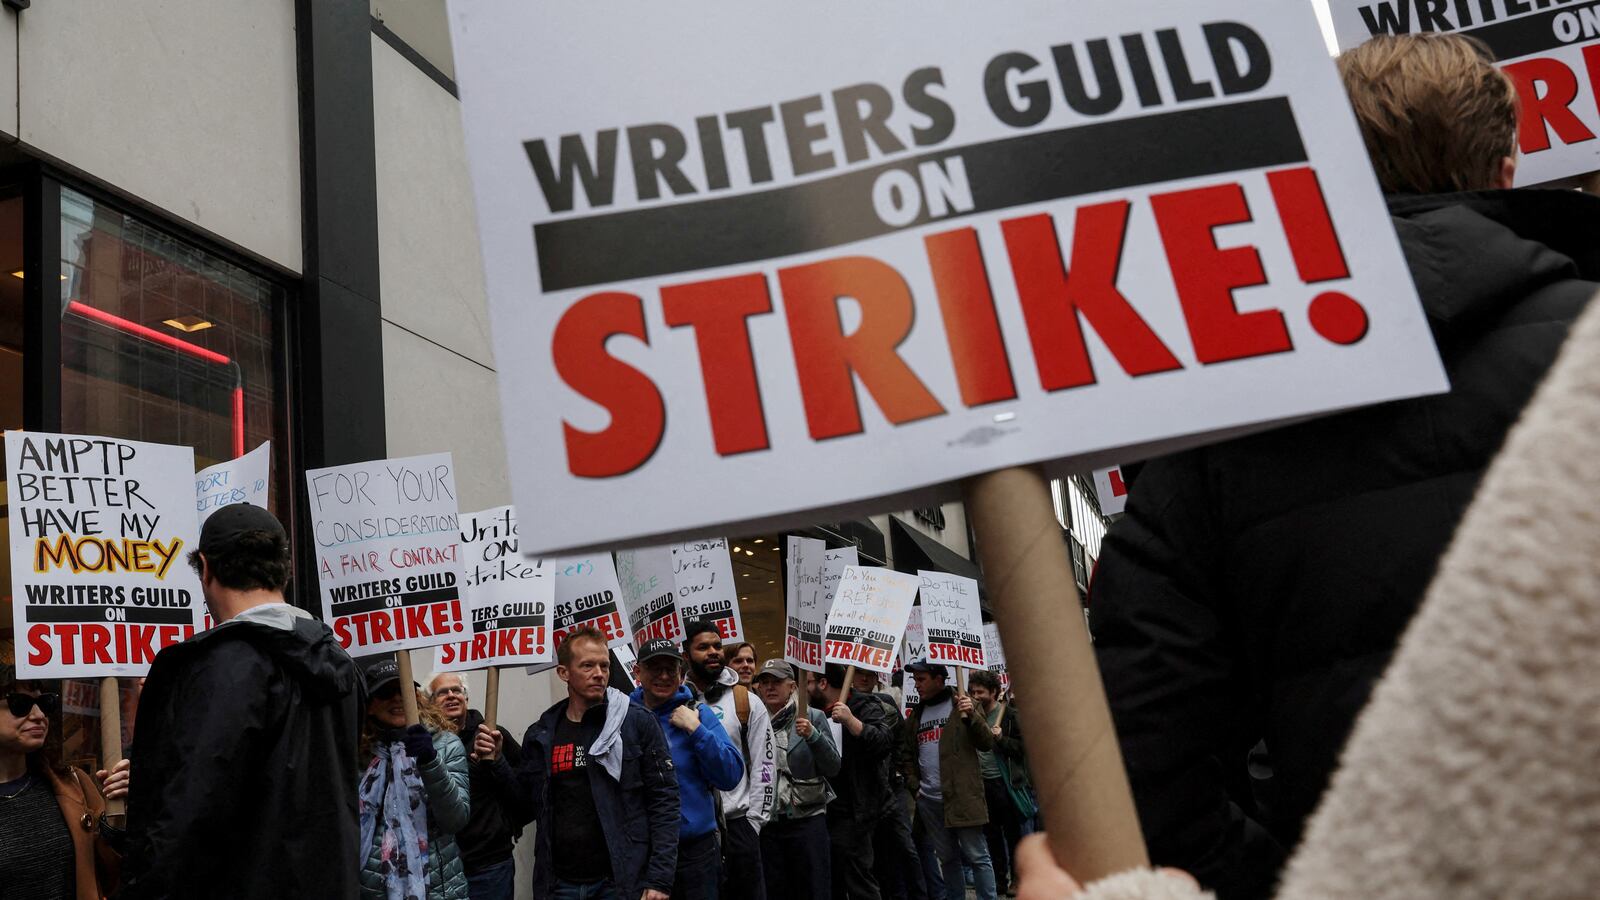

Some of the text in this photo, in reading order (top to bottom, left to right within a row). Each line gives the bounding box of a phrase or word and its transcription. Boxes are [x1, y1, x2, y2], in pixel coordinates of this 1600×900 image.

[523, 20, 1273, 216] WRITERS GUILD
[872, 156, 975, 227] ON
[550, 166, 1370, 479] STRIKE!
[19, 437, 136, 475] AMPTP
[17, 473, 155, 510] BETTER
[313, 465, 453, 512] FOR YOUR
[20, 507, 160, 542] HAVE MY
[316, 513, 460, 547] CONSIDERATION
[34, 533, 184, 581] MONEY
[320, 544, 459, 579] A FAIR CONTRACT
[25, 584, 191, 607] WRITERS GUILD
[329, 572, 456, 603] WRITERS GUILD
[575, 590, 613, 610] GUILD
[385, 595, 402, 607] ON
[502, 602, 545, 616] GUILD
[650, 592, 673, 612] GUILD
[701, 600, 731, 613] GUILD
[104, 608, 126, 621] ON
[334, 600, 463, 649] STRIKE!
[485, 619, 498, 629] ON
[562, 615, 575, 626] ON
[802, 620, 821, 634] GUILD
[828, 624, 896, 643] WRITERS GUILD
[928, 628, 960, 638] WRITERS
[961, 632, 980, 642] GUILD
[826, 639, 892, 668] STRIKE!
[929, 643, 984, 665] STRIKE!
